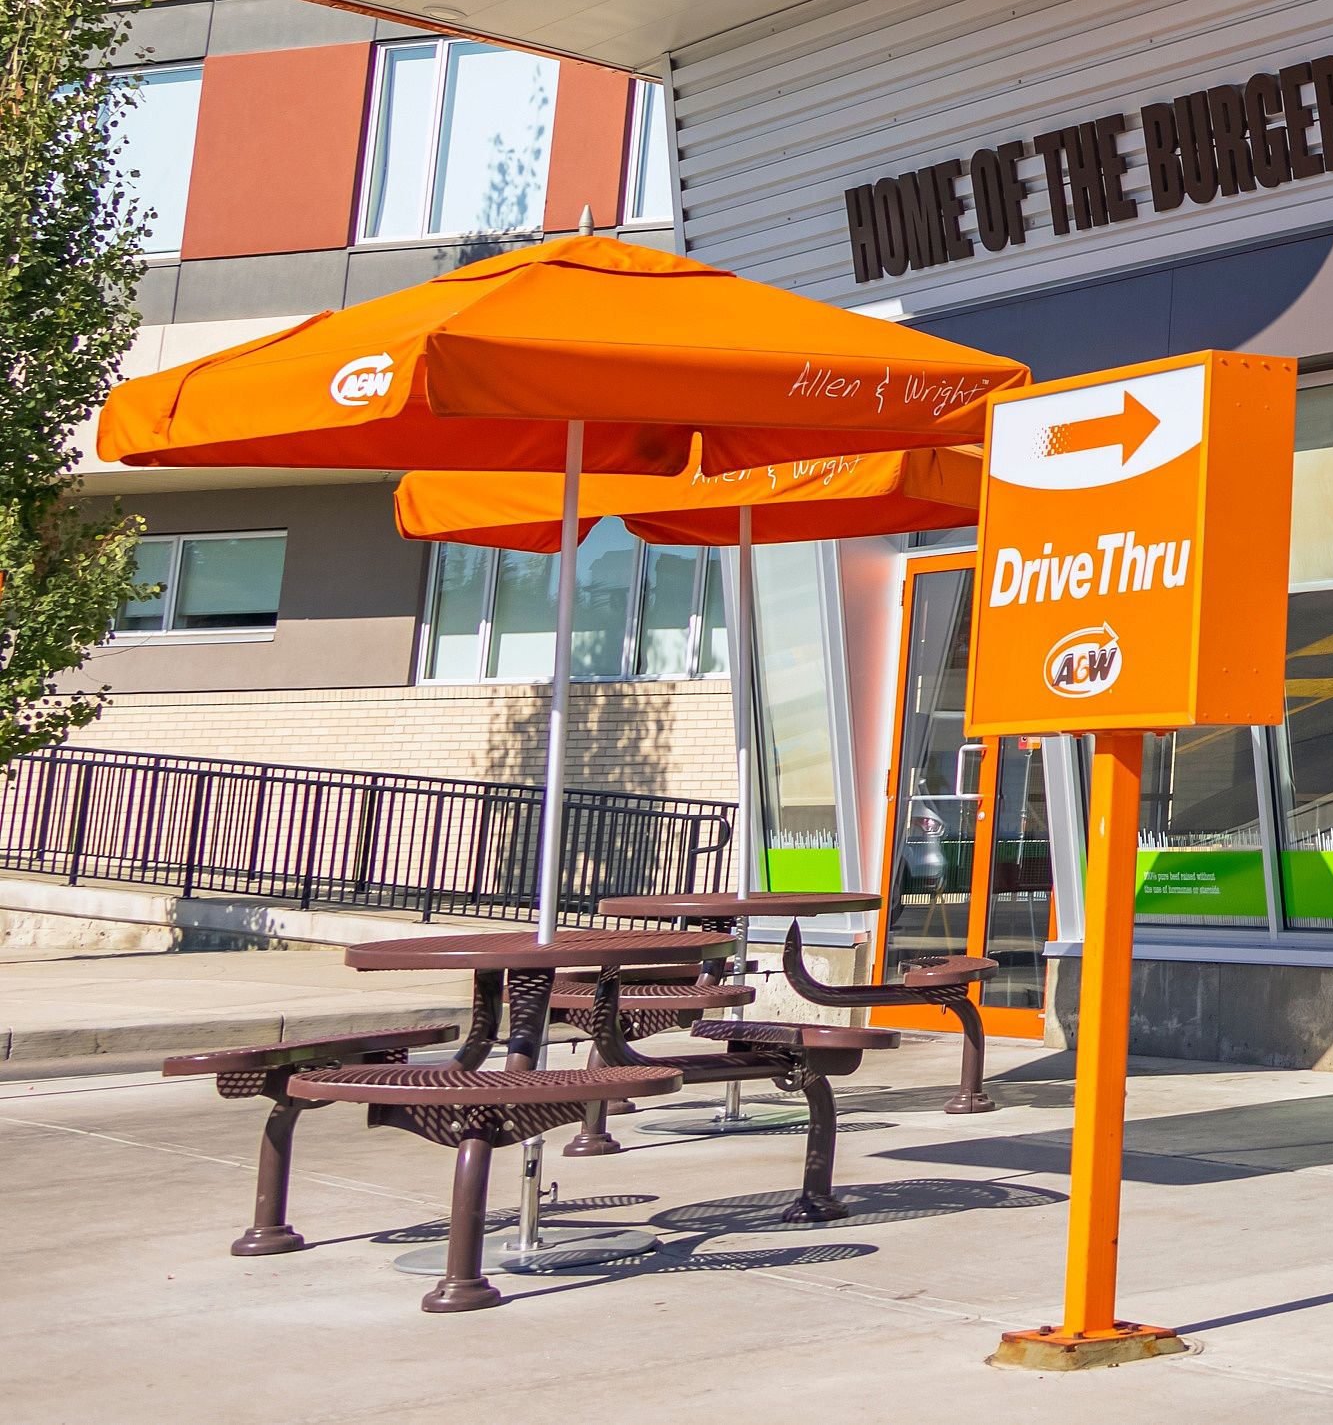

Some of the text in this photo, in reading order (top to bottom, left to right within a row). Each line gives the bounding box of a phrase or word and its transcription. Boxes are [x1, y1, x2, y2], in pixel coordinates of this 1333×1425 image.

[844, 157, 974, 284] HOME
[970, 139, 1027, 252] OF
[1034, 113, 1138, 236] THE
[340, 371, 394, 398] A&W
[788, 360, 861, 398] Allen
[793, 455, 866, 486] Wright
[989, 531, 1191, 608] Drive Thru
[1052, 647, 1118, 686] A&W
[1143, 885, 1152, 894] the
[1153, 886, 1162, 894] use
[1162, 885, 1168, 894] of
[1168, 885, 1192, 894] hormones
[1193, 886, 1199, 894] or
[1157, 872, 1169, 882] pure
[1169, 871, 1180, 881] beef
[1180, 872, 1196, 881] raised
[1196, 871, 1216, 881] without
